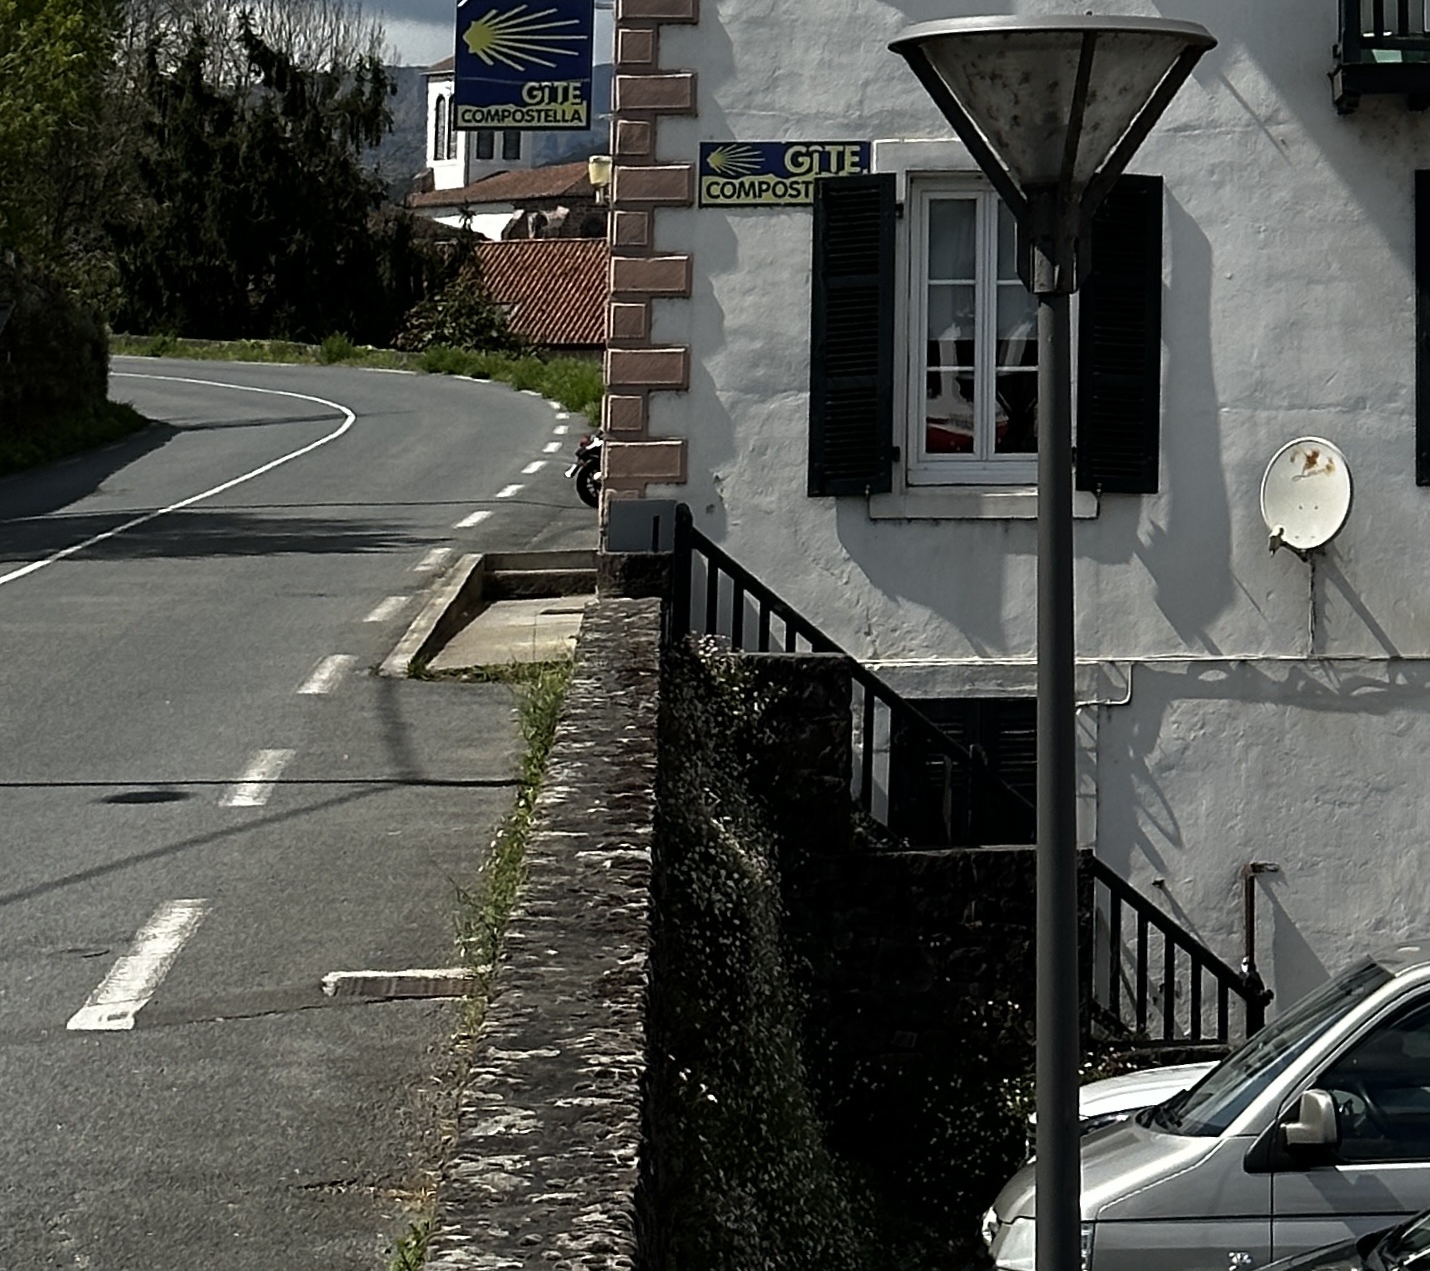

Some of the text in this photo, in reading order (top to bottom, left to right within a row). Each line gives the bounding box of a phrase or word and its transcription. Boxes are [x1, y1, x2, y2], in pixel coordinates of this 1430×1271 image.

[522, 81, 582, 105] GÎTE
[461, 108, 582, 124] COMPOSTELLA
[784, 145, 861, 174] GÎTE
[706, 180, 814, 199] COMPOST
